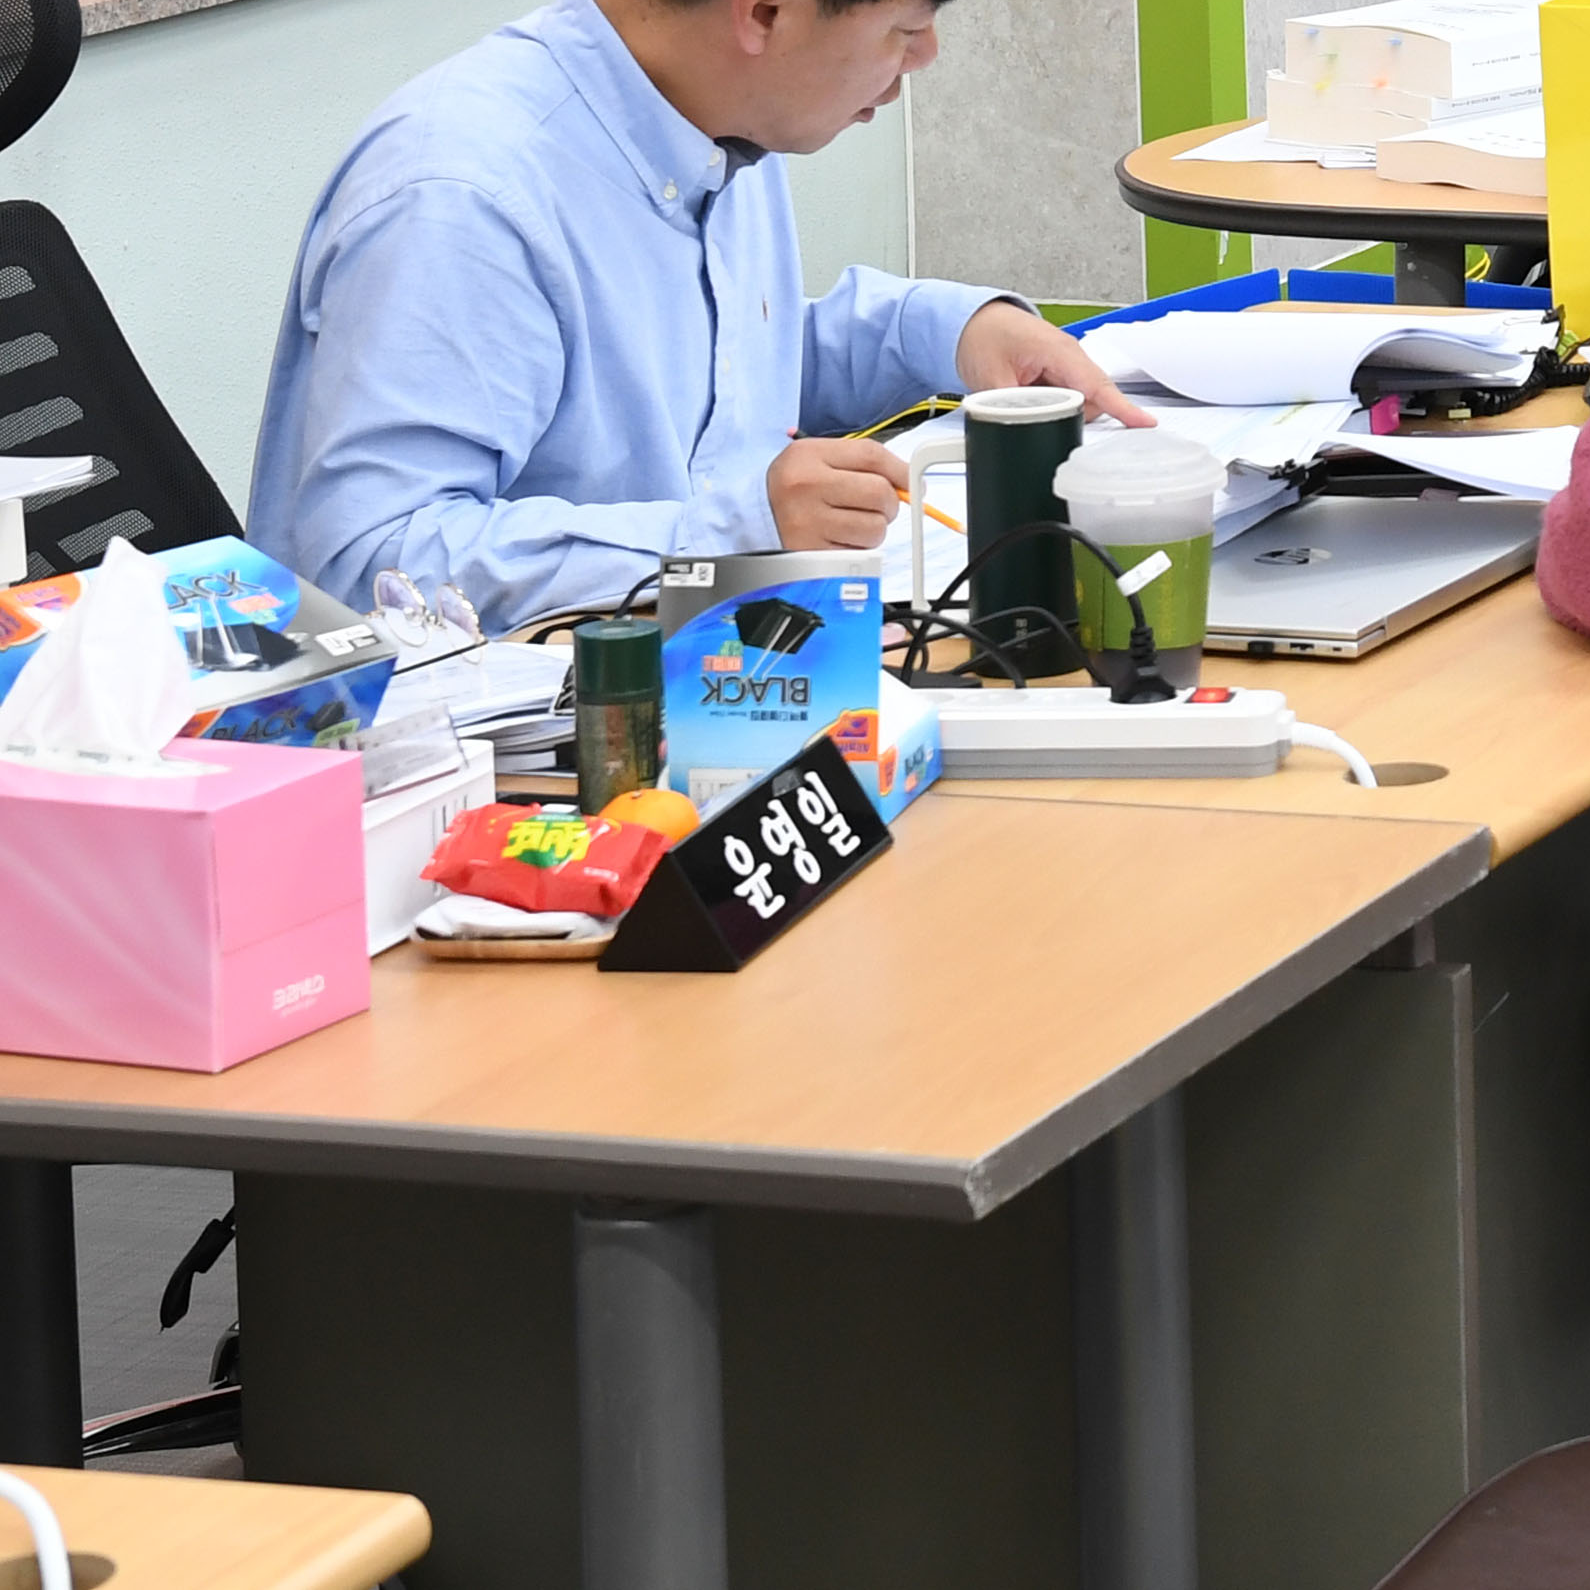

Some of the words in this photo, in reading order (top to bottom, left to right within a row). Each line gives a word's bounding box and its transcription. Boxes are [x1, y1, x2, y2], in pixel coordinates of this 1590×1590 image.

[167, 569, 269, 610] ACK
[701, 675, 811, 706] BLACK
[723, 770, 861, 920] 윤영일
